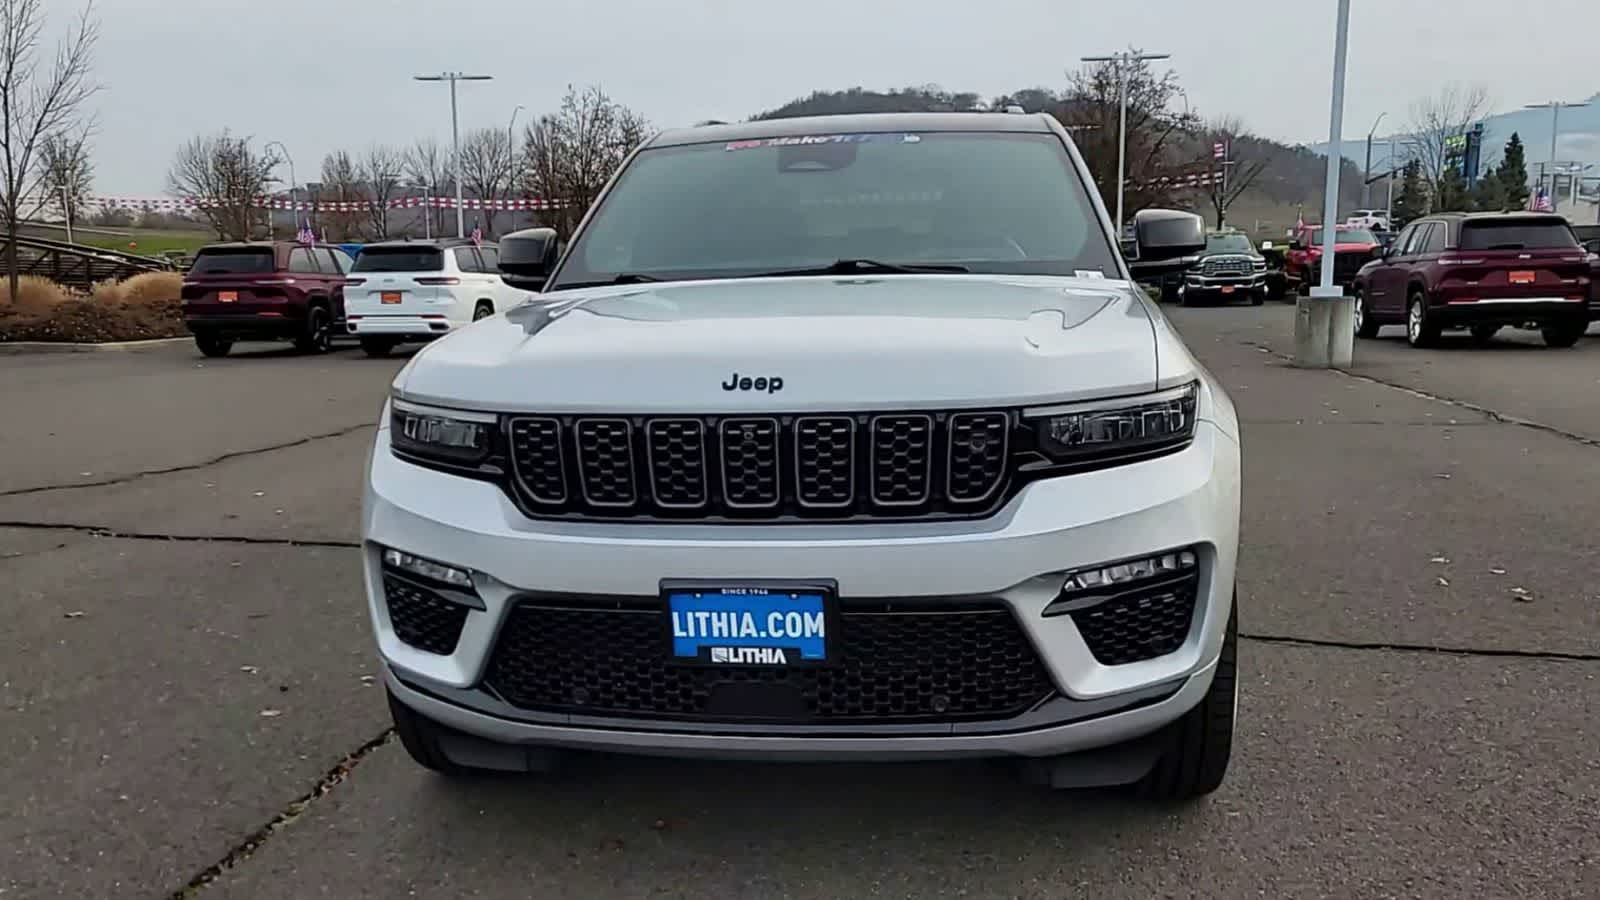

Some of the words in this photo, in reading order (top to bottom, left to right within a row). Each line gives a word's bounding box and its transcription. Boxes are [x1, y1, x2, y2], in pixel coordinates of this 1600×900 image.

[722, 373, 783, 394] Jeep
[672, 611, 825, 638] LITHIA.COM
[728, 647, 787, 664] LITHIA
